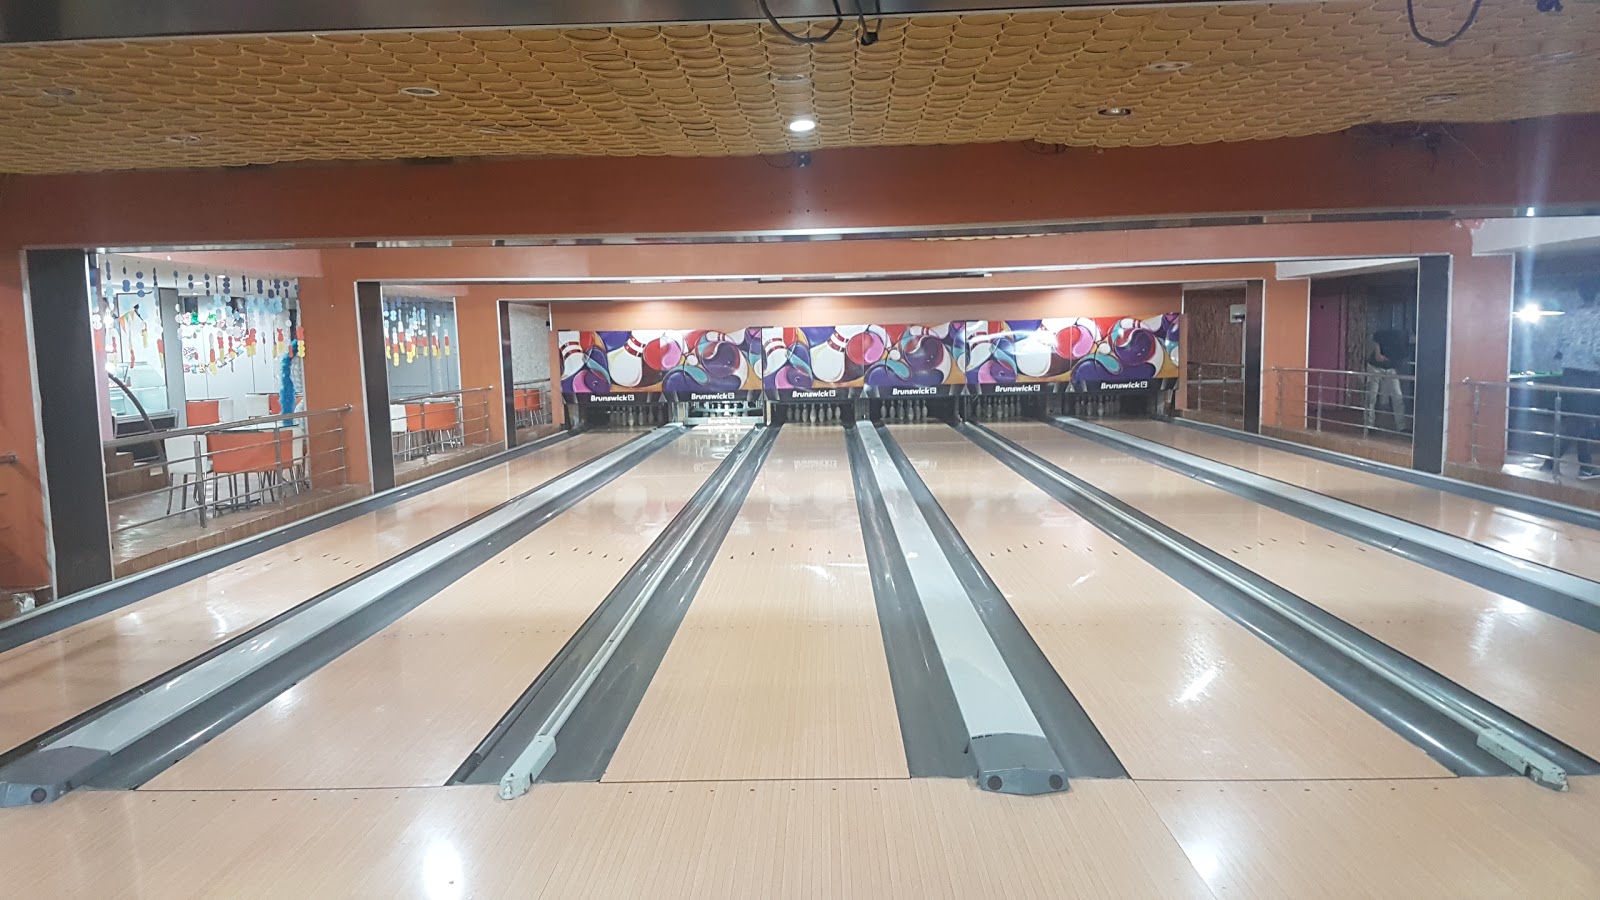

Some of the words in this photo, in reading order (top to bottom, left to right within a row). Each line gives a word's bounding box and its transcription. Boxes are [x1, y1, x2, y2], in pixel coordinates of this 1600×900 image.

[995, 385, 1033, 393] Brunswick
[1101, 381, 1140, 390] Brunswick
[792, 390, 829, 398] Brunswick
[892, 388, 930, 396] Brunswick
